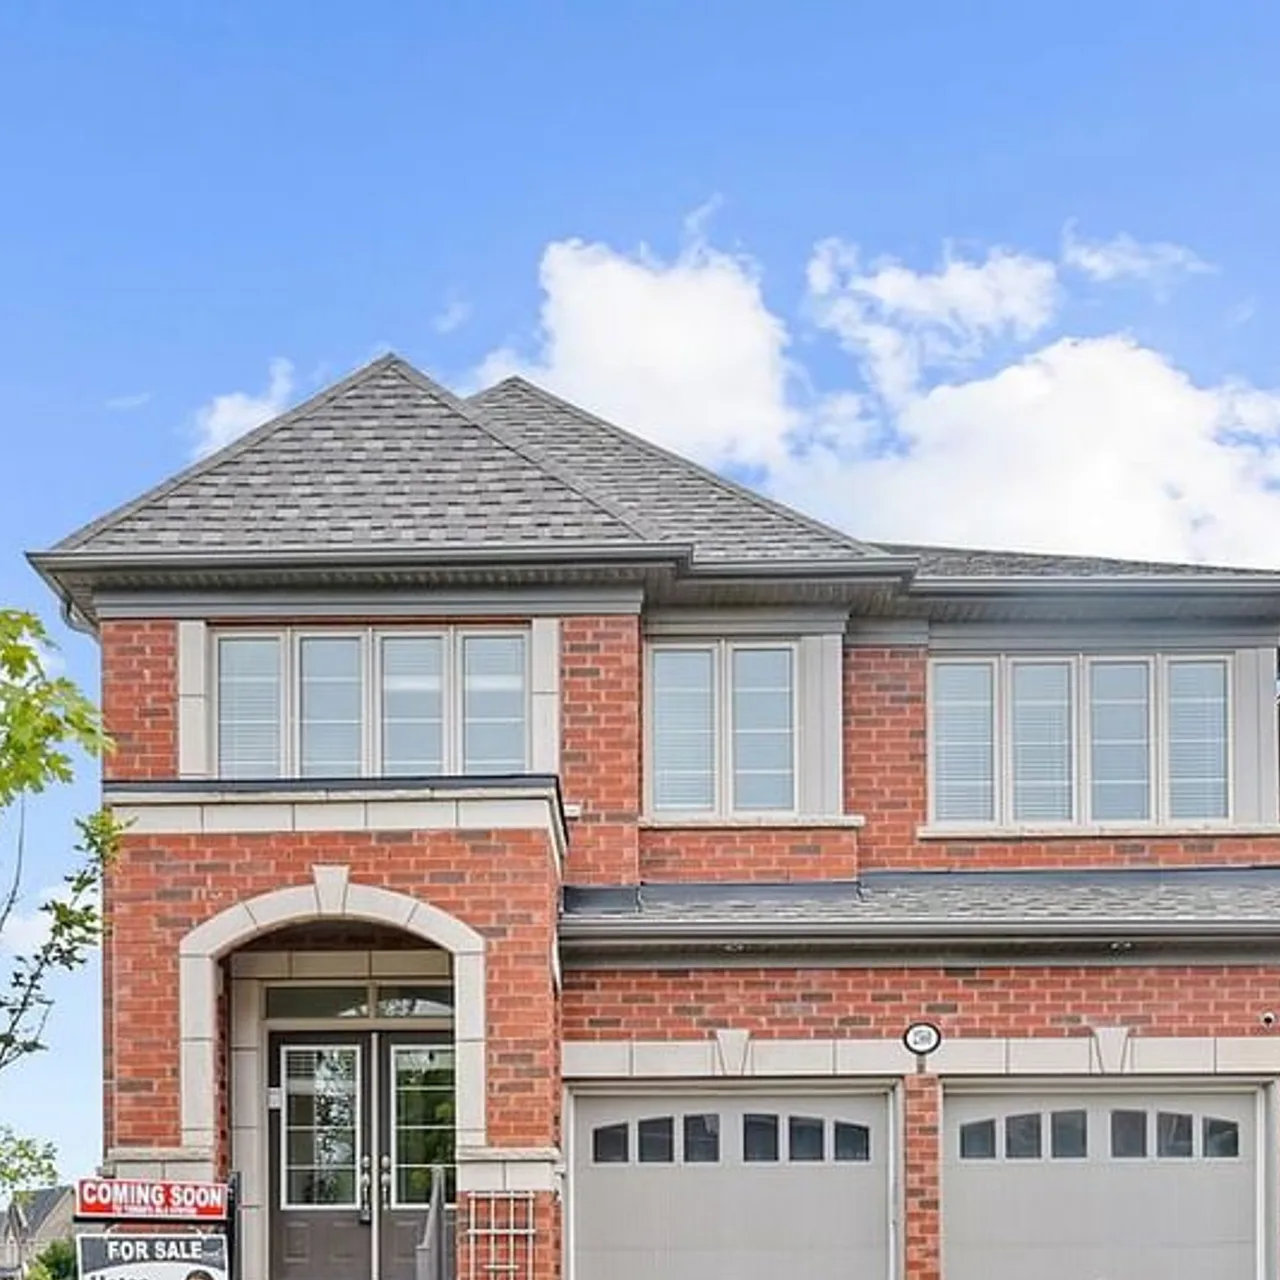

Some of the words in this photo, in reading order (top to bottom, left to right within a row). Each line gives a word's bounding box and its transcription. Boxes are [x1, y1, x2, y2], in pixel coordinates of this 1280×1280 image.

[83, 1182, 166, 1206] COMING
[170, 1186, 222, 1207] SOON
[107, 1240, 149, 1261] FOR
[154, 1240, 203, 1260] SALE
